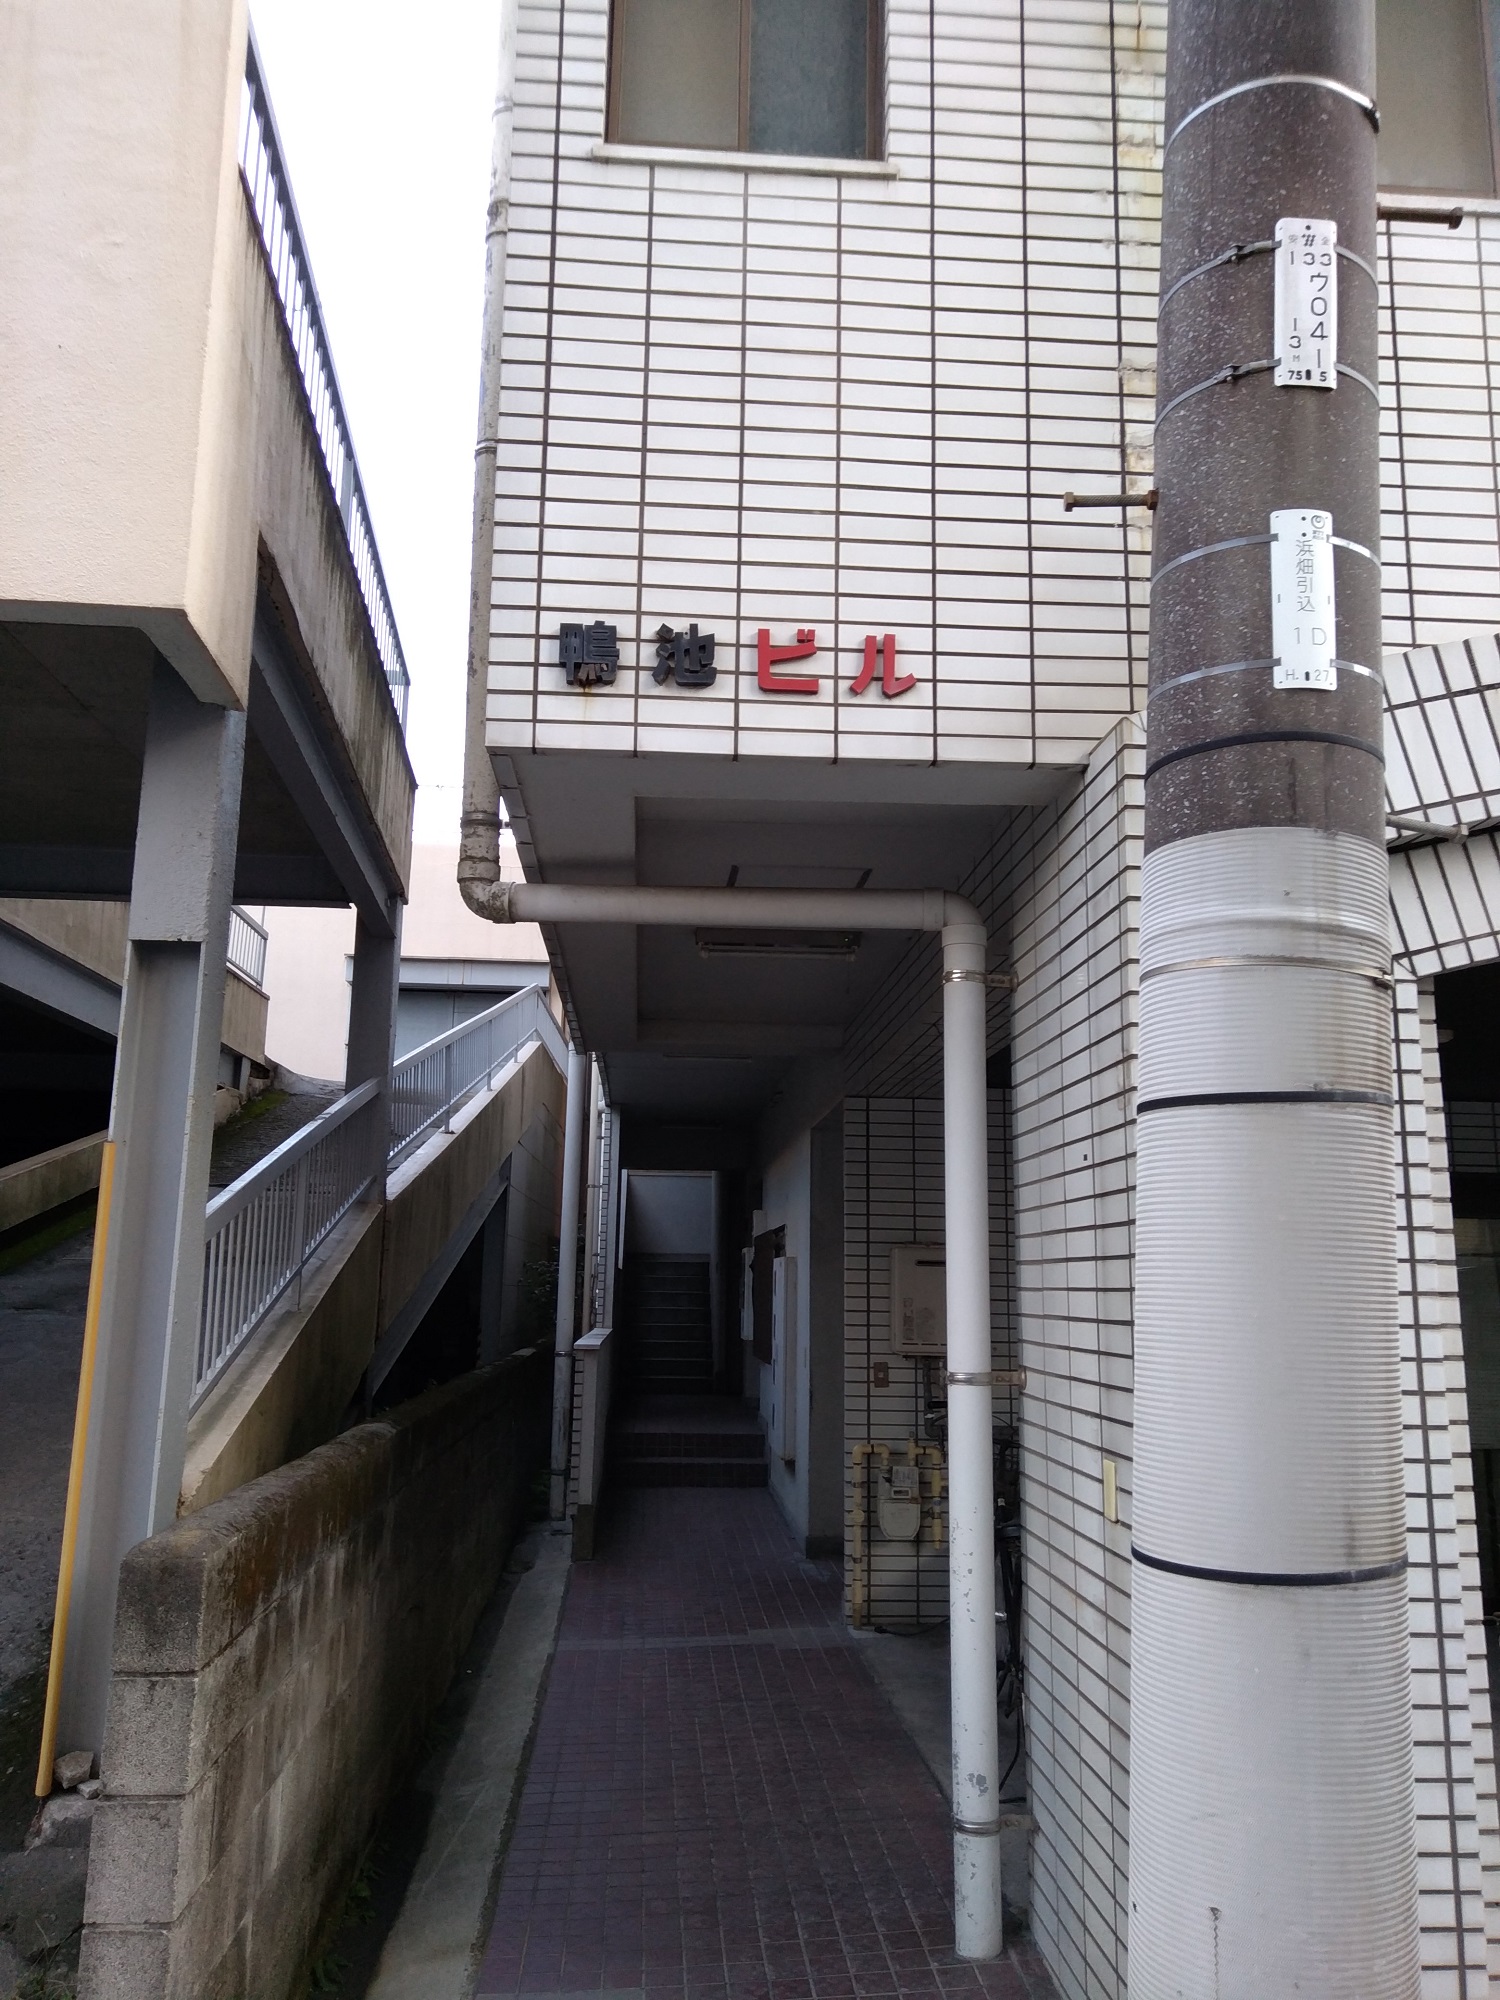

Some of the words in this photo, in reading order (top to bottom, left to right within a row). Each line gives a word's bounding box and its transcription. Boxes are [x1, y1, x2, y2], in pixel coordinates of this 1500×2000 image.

[1289, 250, 1332, 267] 133
[1287, 370, 1303, 380] 75
[1295, 539, 1316, 613] 浜畑引込
[1314, 669, 1330, 682] 27
